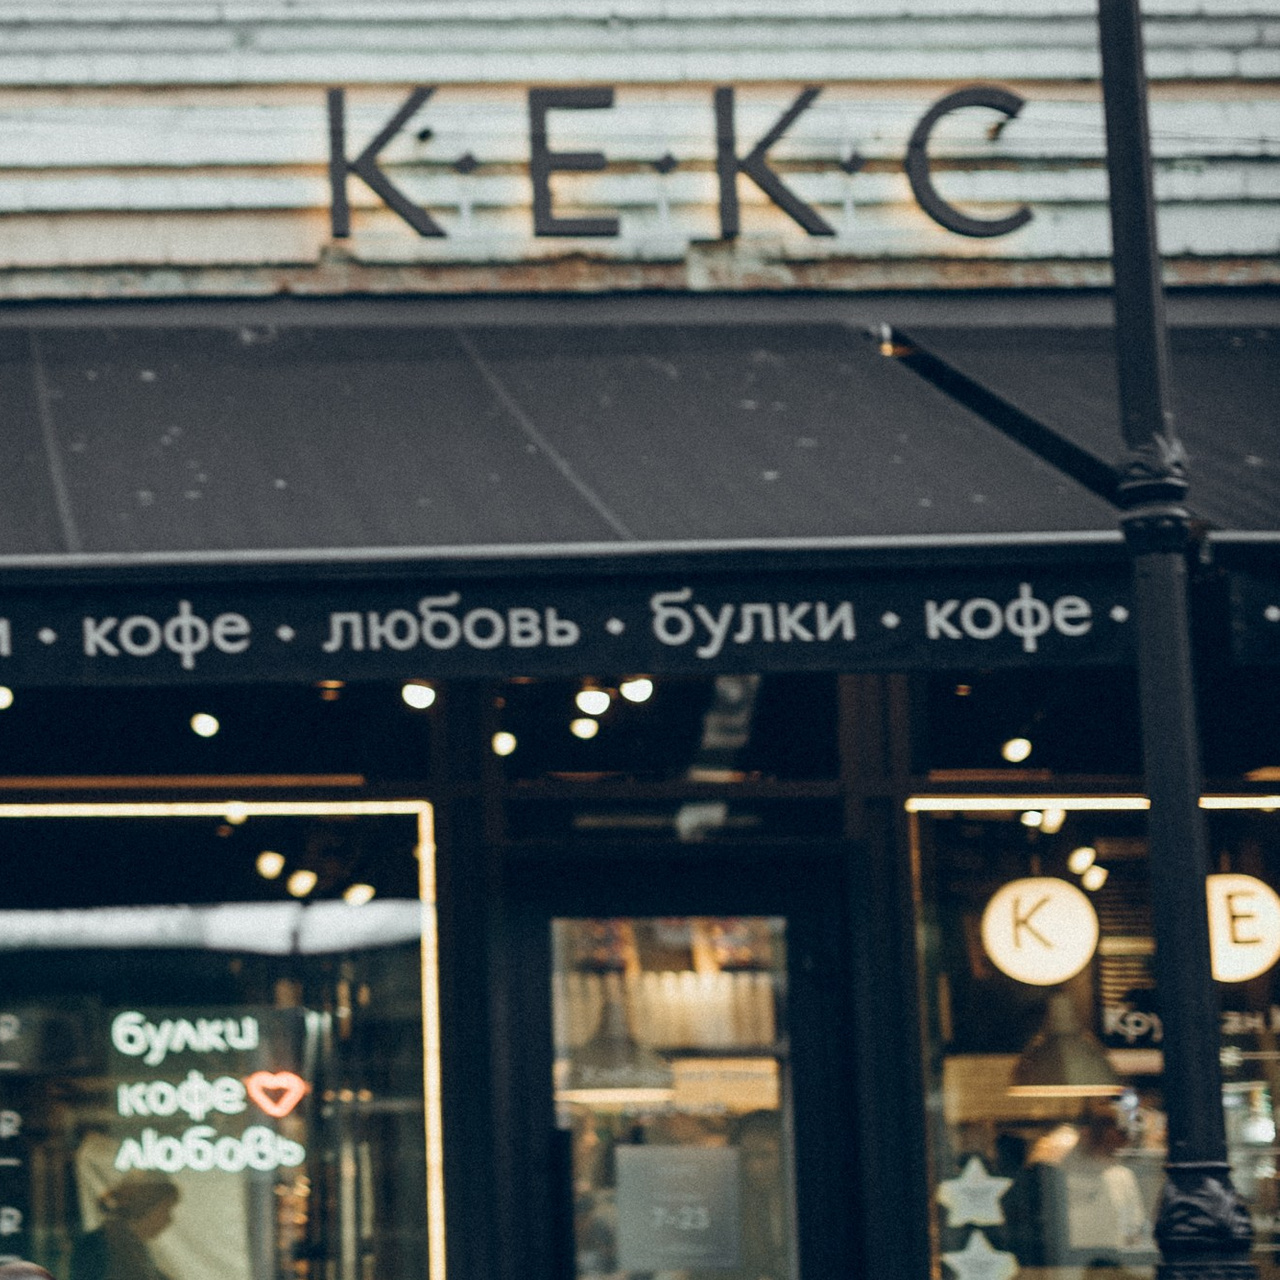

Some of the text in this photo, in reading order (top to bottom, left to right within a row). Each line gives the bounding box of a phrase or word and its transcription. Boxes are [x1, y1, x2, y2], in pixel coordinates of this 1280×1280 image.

[82, 600, 251, 670] кофе
[322, 591, 581, 654] любовь
[650, 587, 856, 659] булки
[925, 582, 1093, 654] кофе
[111, 1011, 260, 1065] булки
[117, 1069, 248, 1120] кофе
[114, 1125, 306, 1173] любовь
